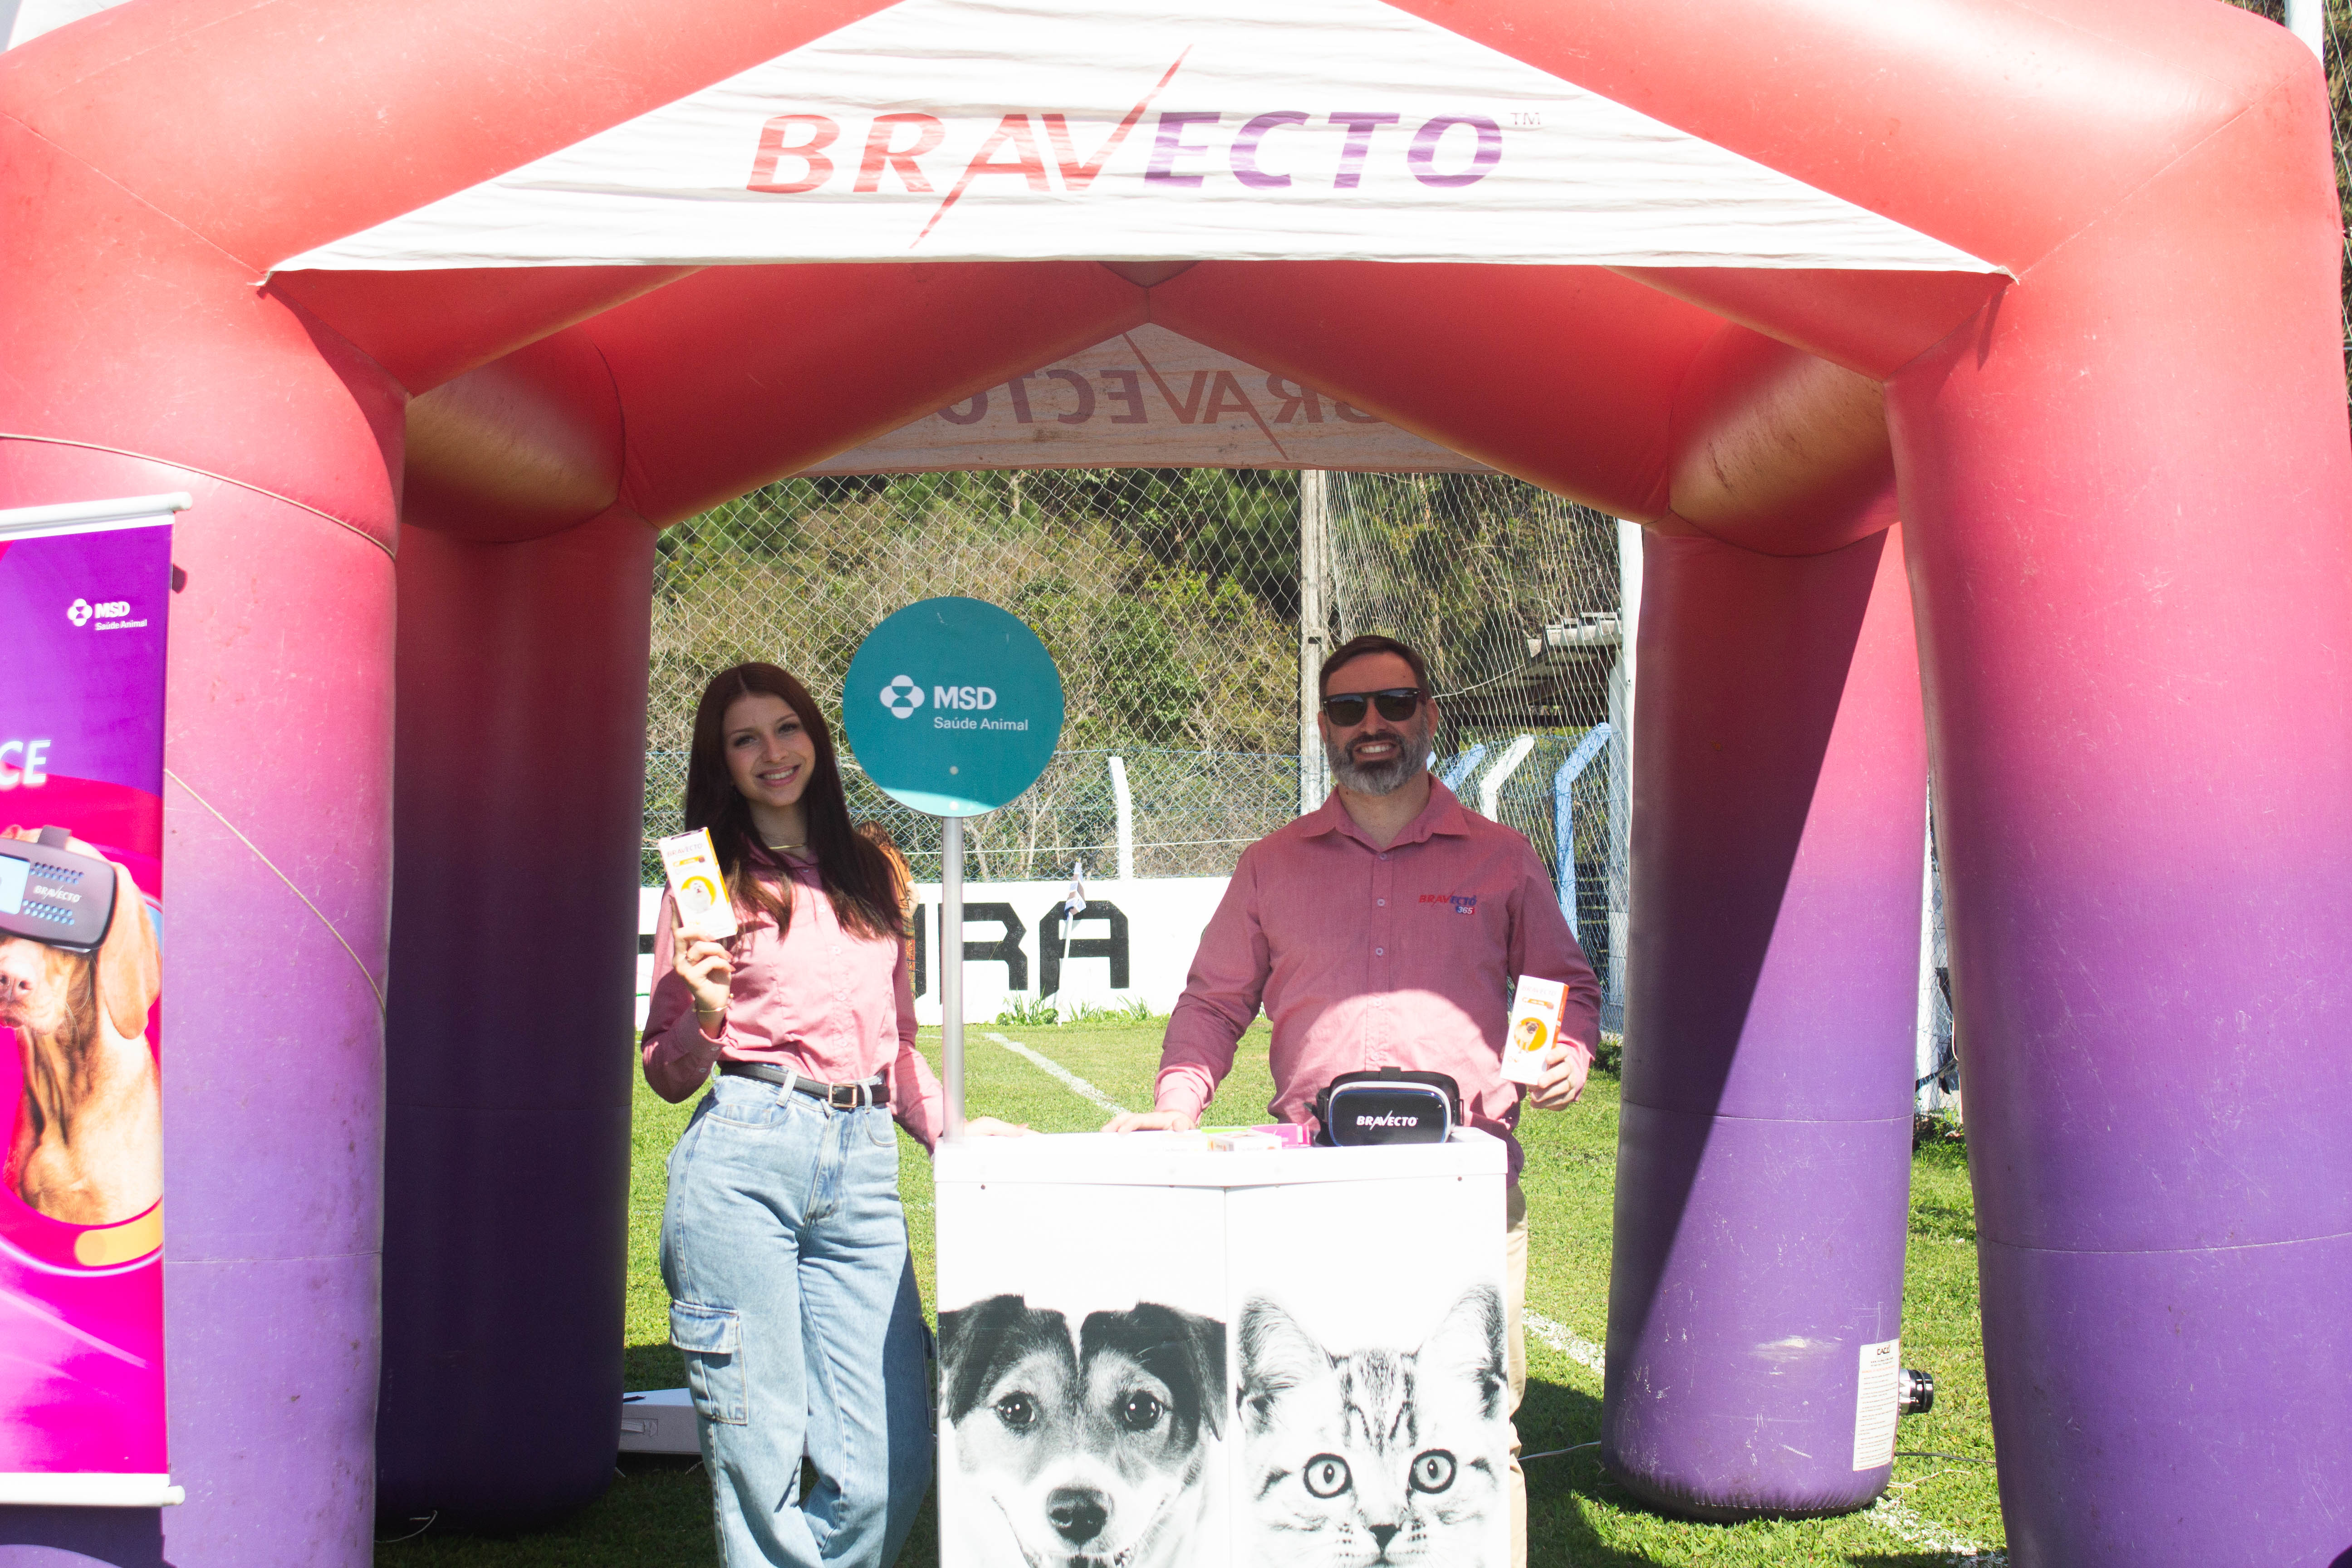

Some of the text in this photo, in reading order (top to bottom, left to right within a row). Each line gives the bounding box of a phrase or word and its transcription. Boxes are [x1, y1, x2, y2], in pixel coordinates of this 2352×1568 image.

[746, 44, 1503, 249] BRAVECTO
[95, 601, 130, 618] MSD
[95, 619, 147, 630] Saúde Animal
[934, 686, 997, 710] MSD
[934, 716, 1028, 730] Saúde Animal
[34, 886, 81, 903] BRAVECTO
[1419, 890, 1477, 907] BRAVECTO
[1457, 906, 1473, 914] 365
[1356, 1110, 1417, 1131] BRAVECTO
